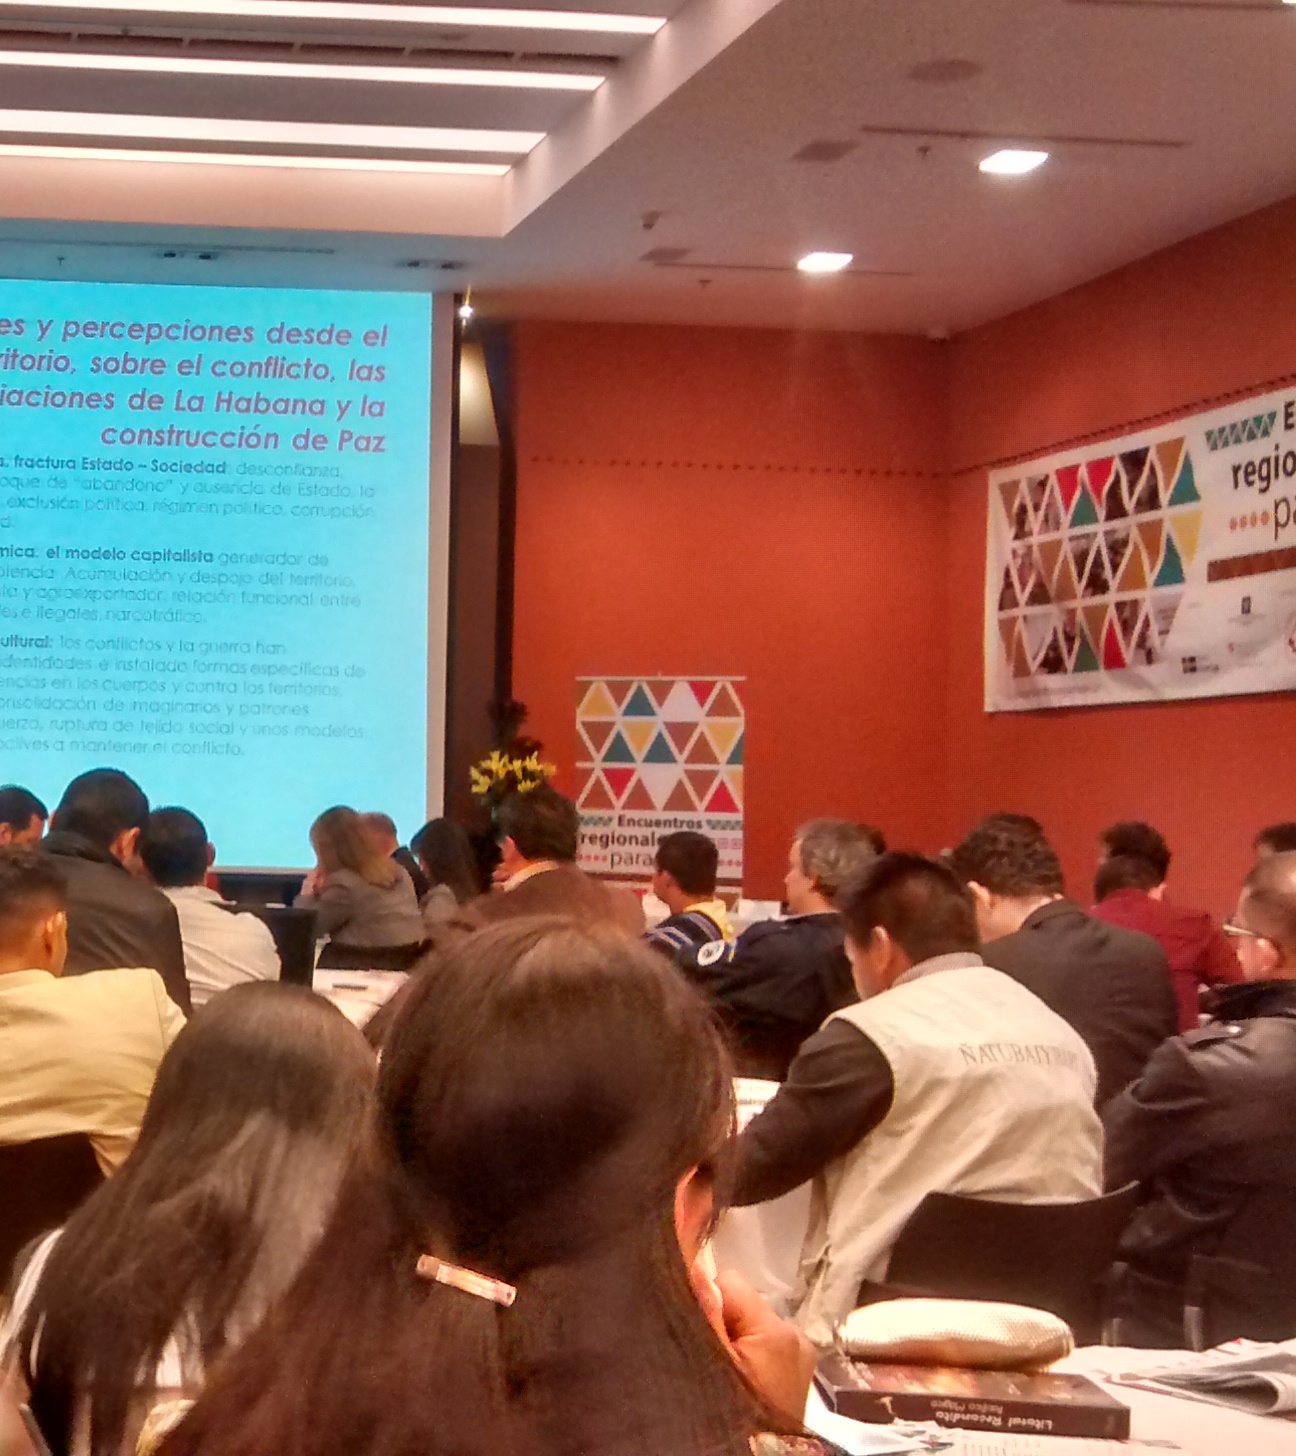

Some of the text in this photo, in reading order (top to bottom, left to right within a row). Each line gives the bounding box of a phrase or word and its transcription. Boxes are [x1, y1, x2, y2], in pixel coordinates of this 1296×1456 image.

[37, 318, 52, 342] y
[62, 317, 254, 346] percepciones
[266, 322, 352, 346] desde
[363, 323, 388, 348] el
[90, 351, 166, 376] sobre
[176, 354, 202, 378] el
[210, 355, 336, 383] conflicto,
[348, 358, 386, 383] las
[127, 388, 164, 412] de
[173, 390, 205, 413] La
[214, 391, 326, 417] Habana
[335, 400, 350, 422] y
[359, 394, 386, 419] la
[100, 423, 386, 454] construcción de Paz
[14, 455, 76, 469] fractura
[82, 456, 134, 472] Estado
[47, 474, 67, 489] de
[179, 482, 188, 494] y
[193, 480, 263, 494] ausencia
[270, 481, 290, 496] de
[359, 484, 375, 498] la
[6, 493, 78, 510] exclusión
[290, 501, 374, 519] corrupción
[46, 546, 59, 559] el
[65, 547, 126, 561] modelo
[131, 549, 214, 565] capitalista
[218, 551, 303, 567] generador
[308, 553, 328, 566] de
[65, 566, 172, 583] Acumulación
[178, 572, 185, 584] y
[259, 572, 283, 585] del
[23, 587, 32, 600] y
[171, 589, 238, 603] relación
[241, 590, 314, 606] funcional
[320, 593, 361, 607] entre
[22, 609, 31, 619] e
[60, 636, 80, 649] los
[85, 636, 162, 652] conflictos
[166, 642, 174, 652] y
[180, 640, 194, 652] la
[198, 642, 251, 656] guerra
[256, 641, 287, 655] han
[0, 655, 92, 670] identidades
[99, 660, 109, 671] e
[115, 657, 187, 673] instalado
[193, 659, 247, 673] formas
[251, 662, 339, 677] específicas
[345, 665, 365, 677] de
[51, 679, 72, 689] en
[77, 677, 98, 690] los
[102, 678, 166, 694] cuerpos
[173, 682, 181, 694] y
[185, 680, 237, 693] contra
[244, 682, 264, 694] los
[103, 699, 124, 712] de
[130, 700, 220, 715] imaginarios
[226, 704, 234, 716] y
[239, 702, 308, 717] patrones
[50, 718, 107, 732] ruptura
[112, 718, 134, 731] de
[140, 720, 183, 736] tejido
[189, 721, 234, 734] social
[240, 724, 248, 737] y
[253, 725, 288, 735] unos
[295, 724, 363, 738] modelos
[55, 740, 63, 751] a
[70, 740, 148, 753] mantener
[153, 741, 167, 753] el
[617, 815, 703, 829] Encuentros
[610, 852, 654, 869] para
